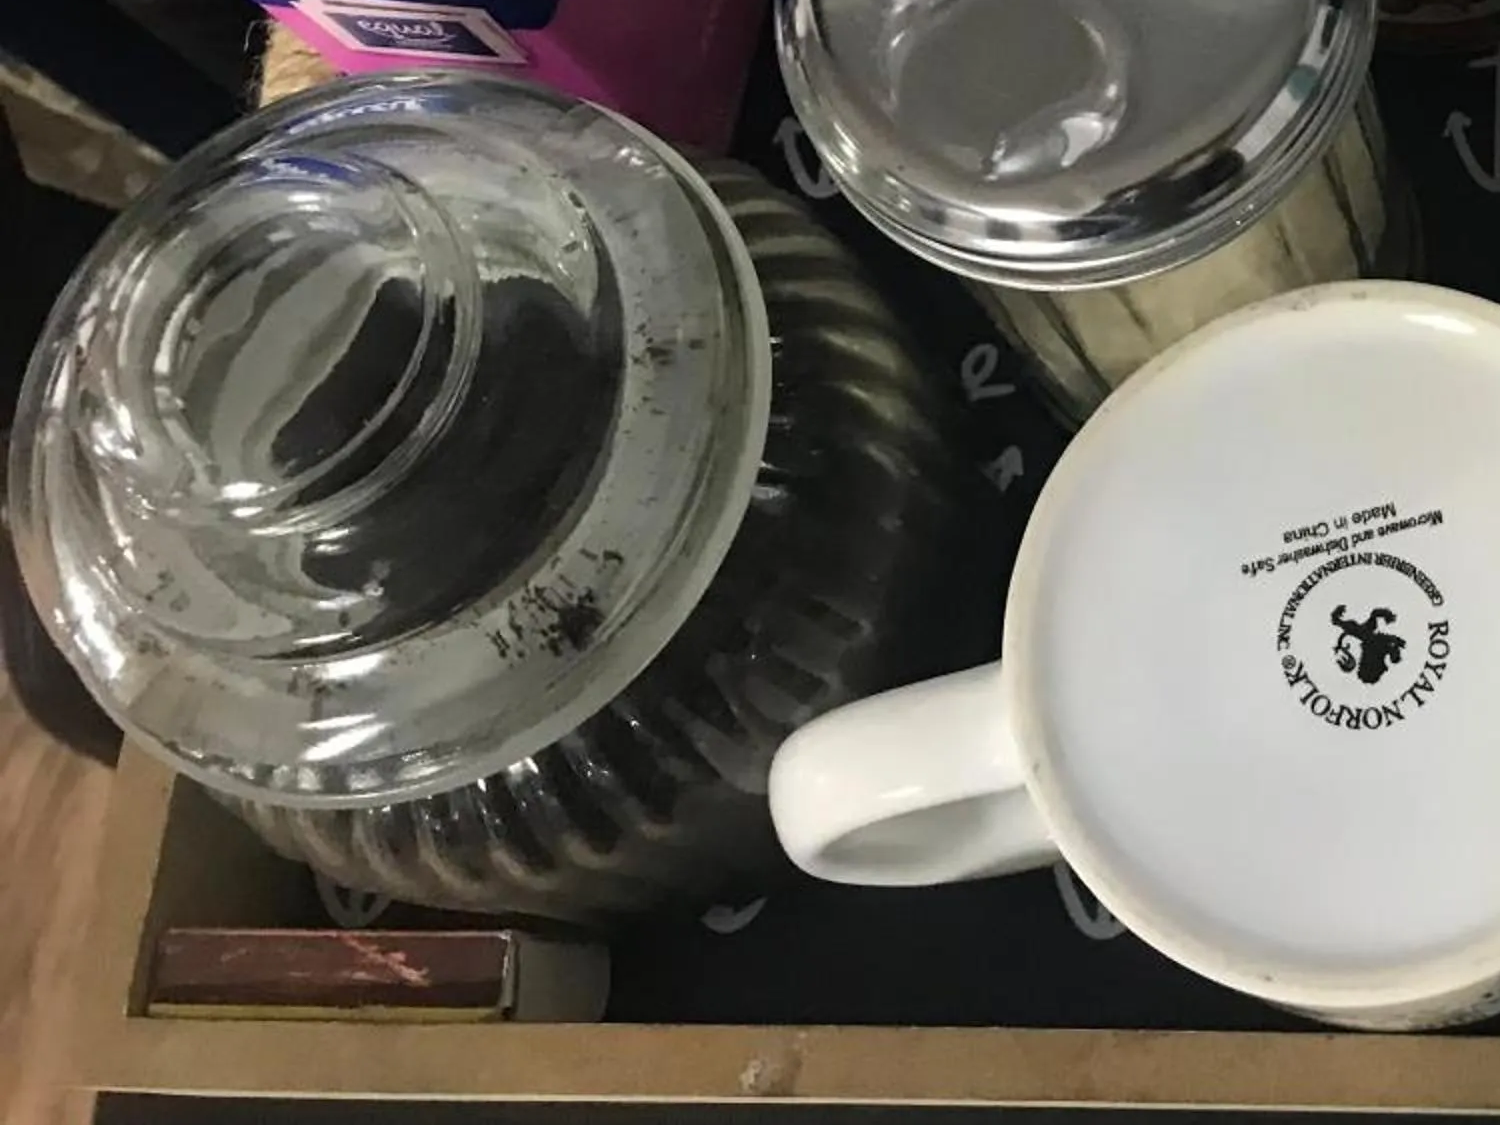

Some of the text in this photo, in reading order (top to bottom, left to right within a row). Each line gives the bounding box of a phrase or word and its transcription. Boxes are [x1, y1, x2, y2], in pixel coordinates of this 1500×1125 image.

[1241, 509, 1444, 577] Microwave and Dishwasher Safe
[1283, 502, 1397, 544] Made in China
[1401, 620, 1450, 707] ROYAL
